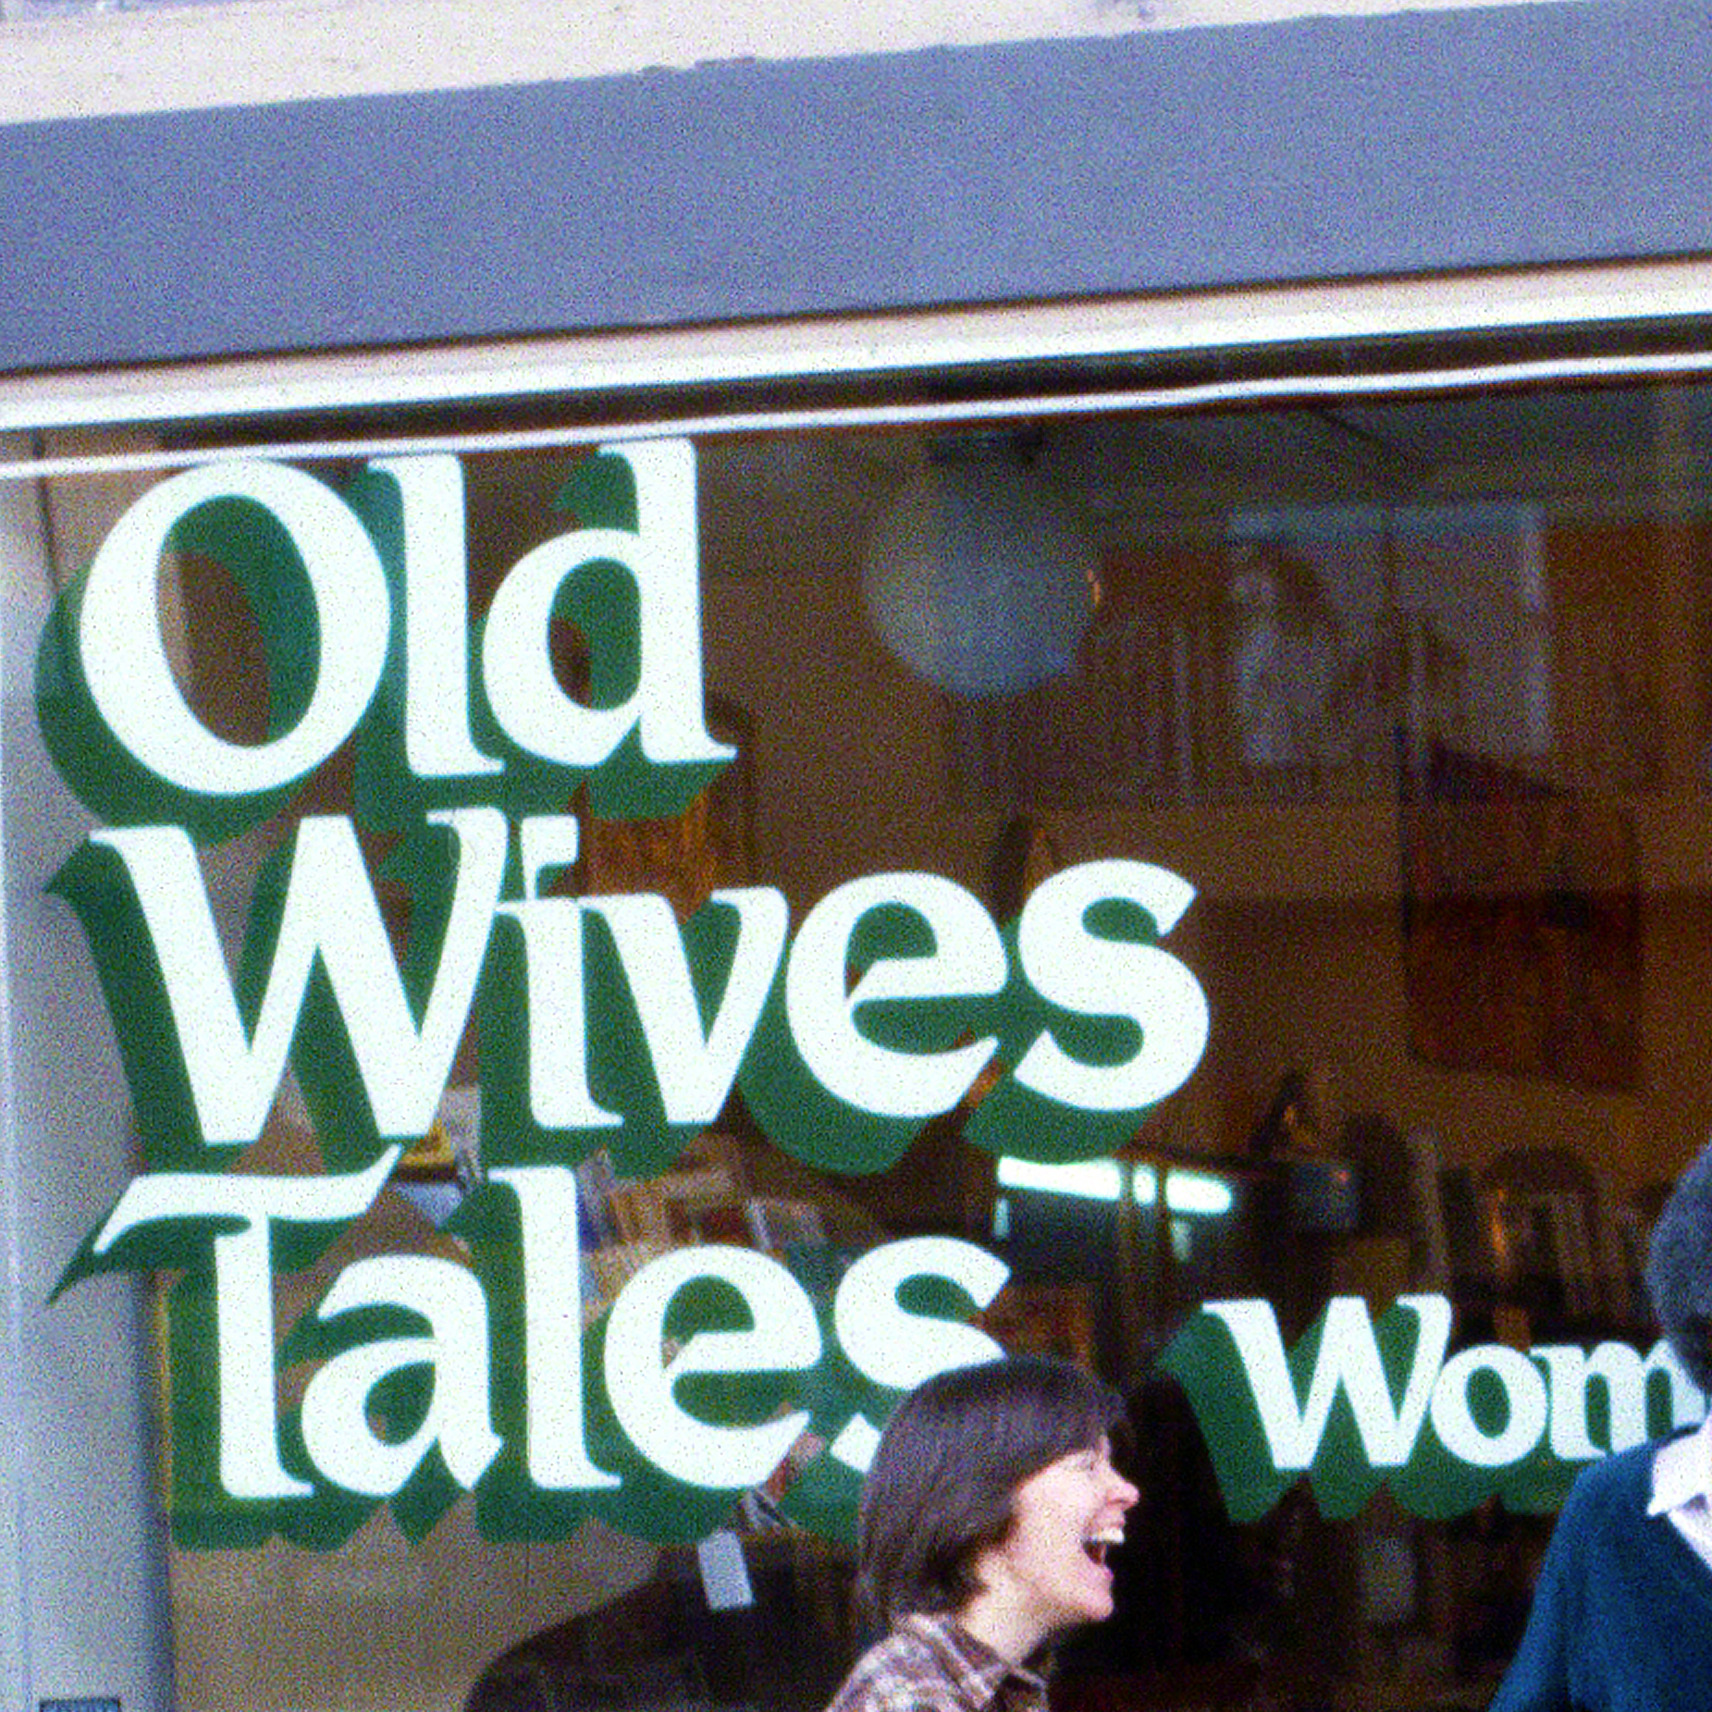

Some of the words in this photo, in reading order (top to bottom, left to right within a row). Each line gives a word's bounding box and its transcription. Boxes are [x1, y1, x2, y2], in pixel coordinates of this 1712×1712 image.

[78, 438, 737, 798] Old
[88, 803, 1210, 1147] Wives
[92, 1143, 1012, 1502] Tales
